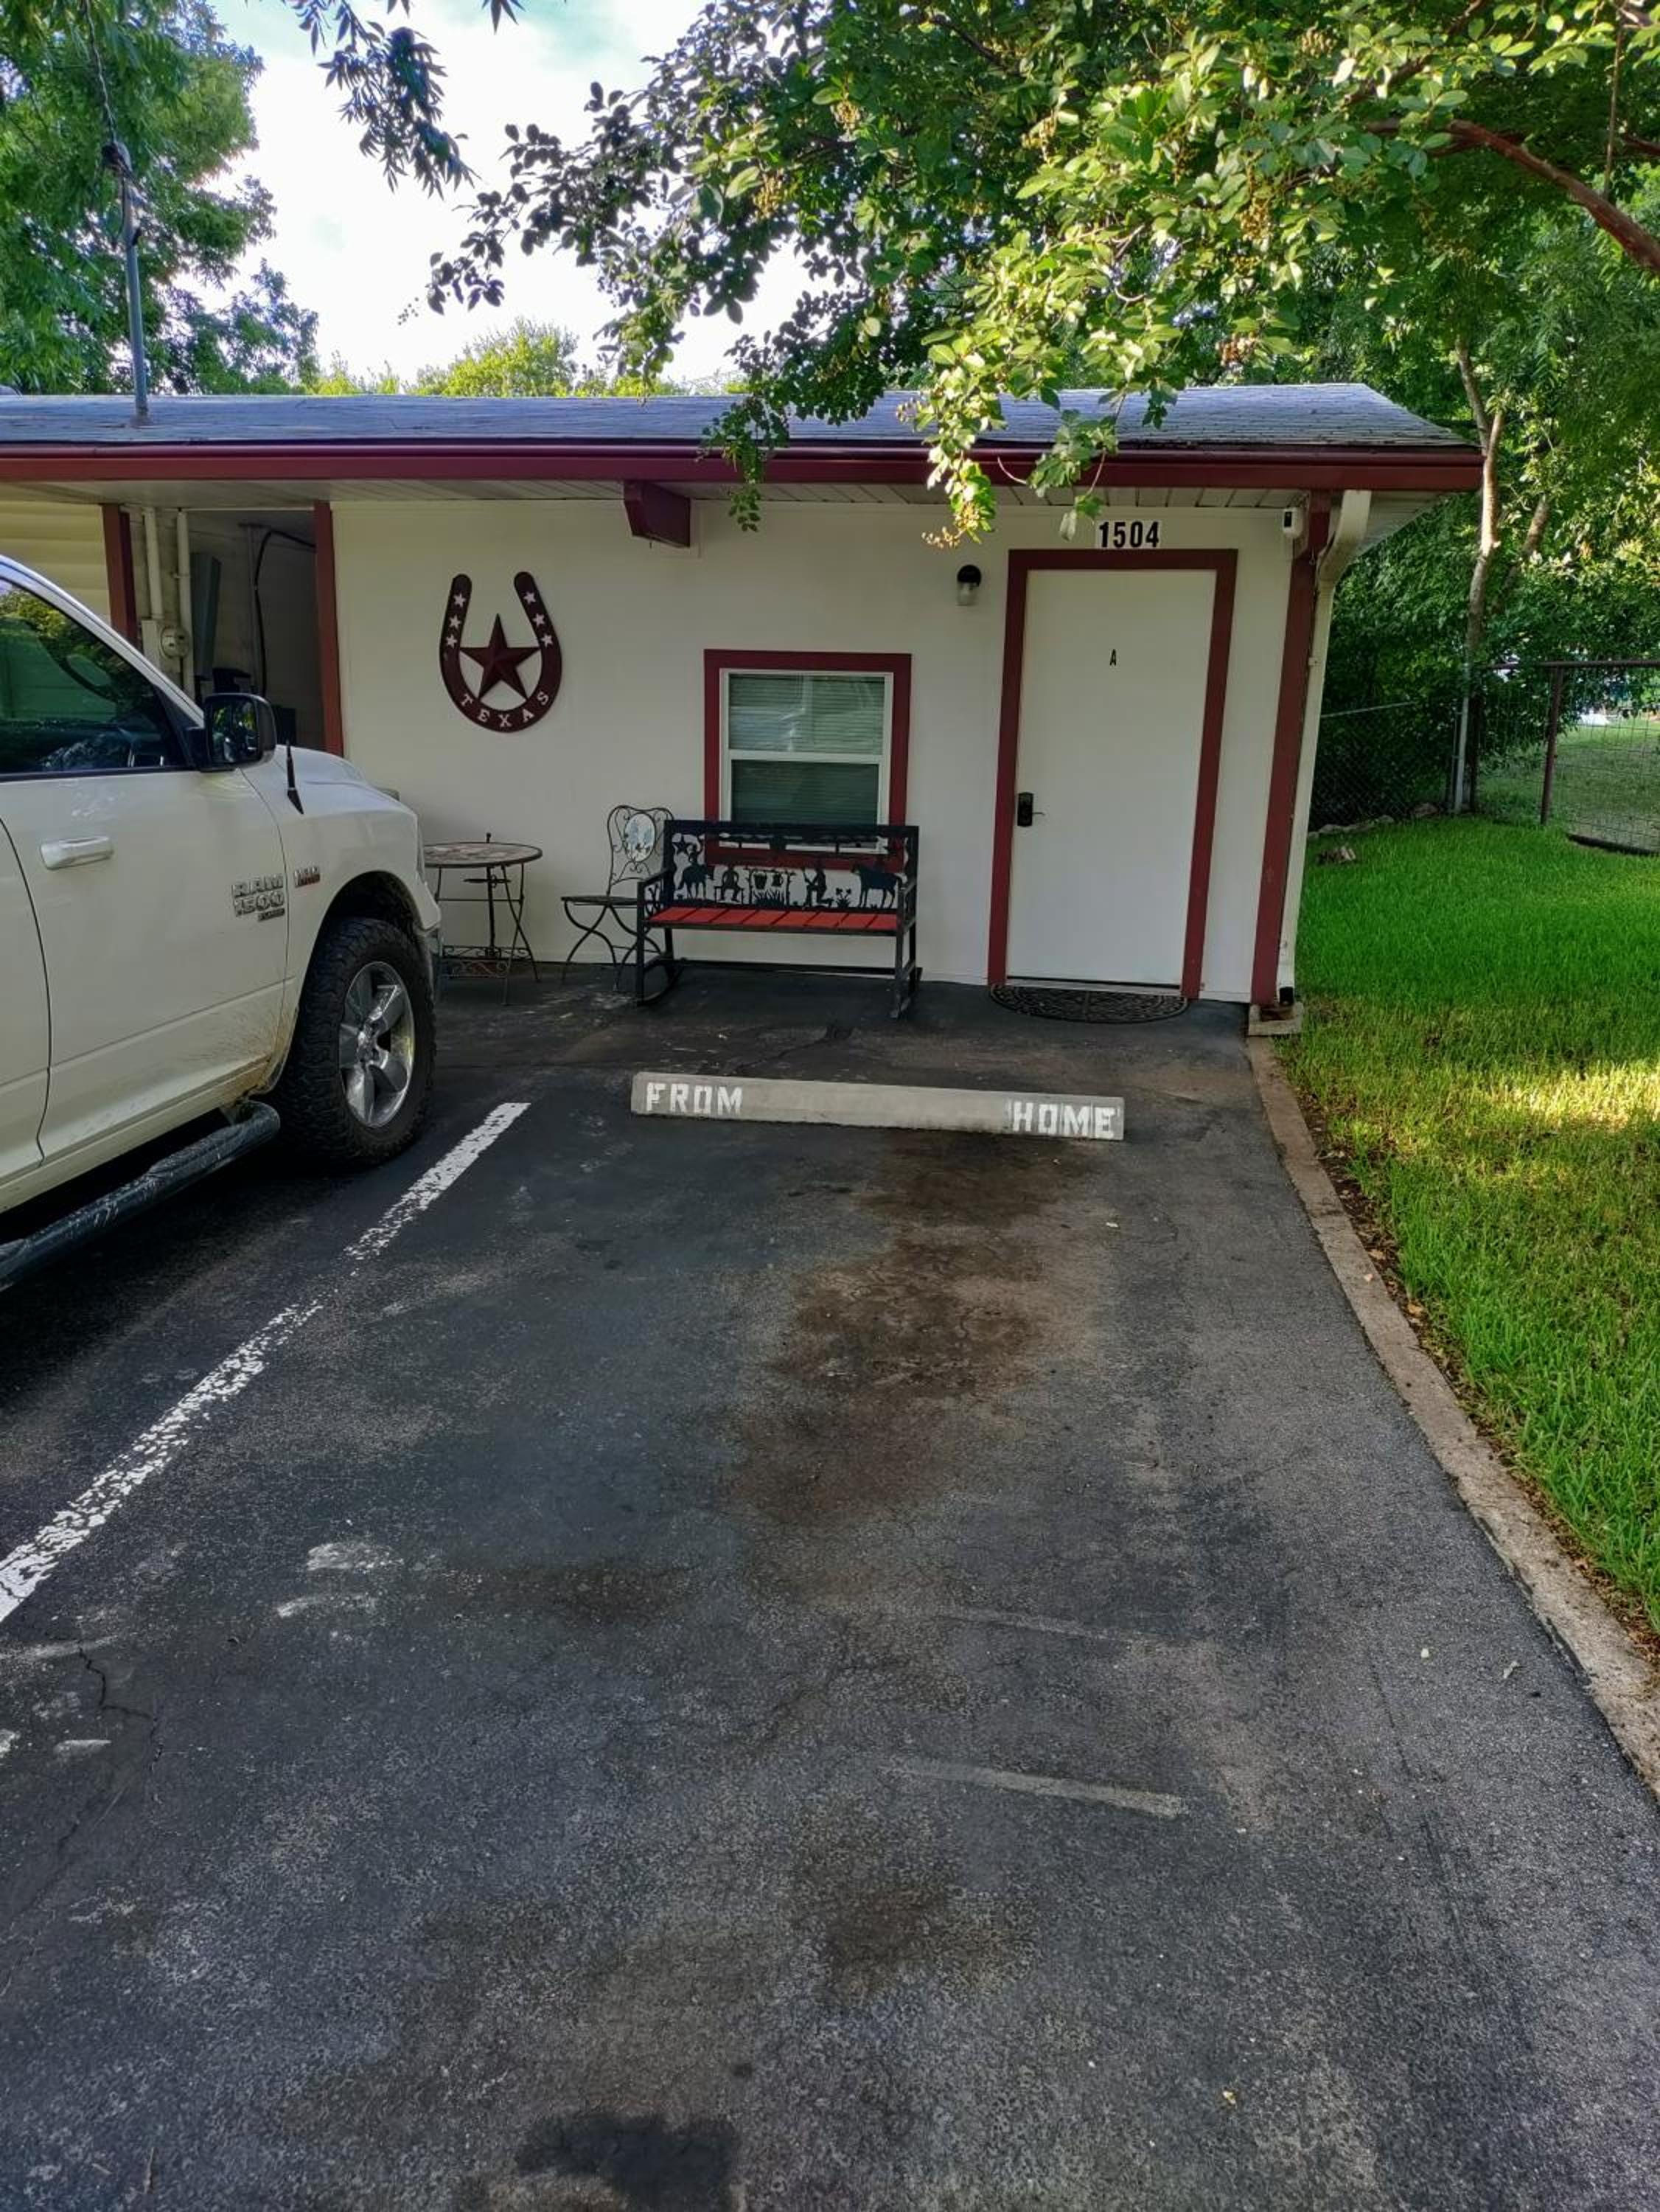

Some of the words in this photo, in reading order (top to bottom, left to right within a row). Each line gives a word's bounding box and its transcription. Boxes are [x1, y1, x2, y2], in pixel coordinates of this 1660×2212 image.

[1099, 521, 1159, 548] 1504
[1109, 649, 1117, 667] A
[461, 692, 549, 727] TEXAS
[231, 874, 283, 897] RAM
[646, 1082, 742, 1116] FROM
[1013, 1102, 1115, 1138] HOME
